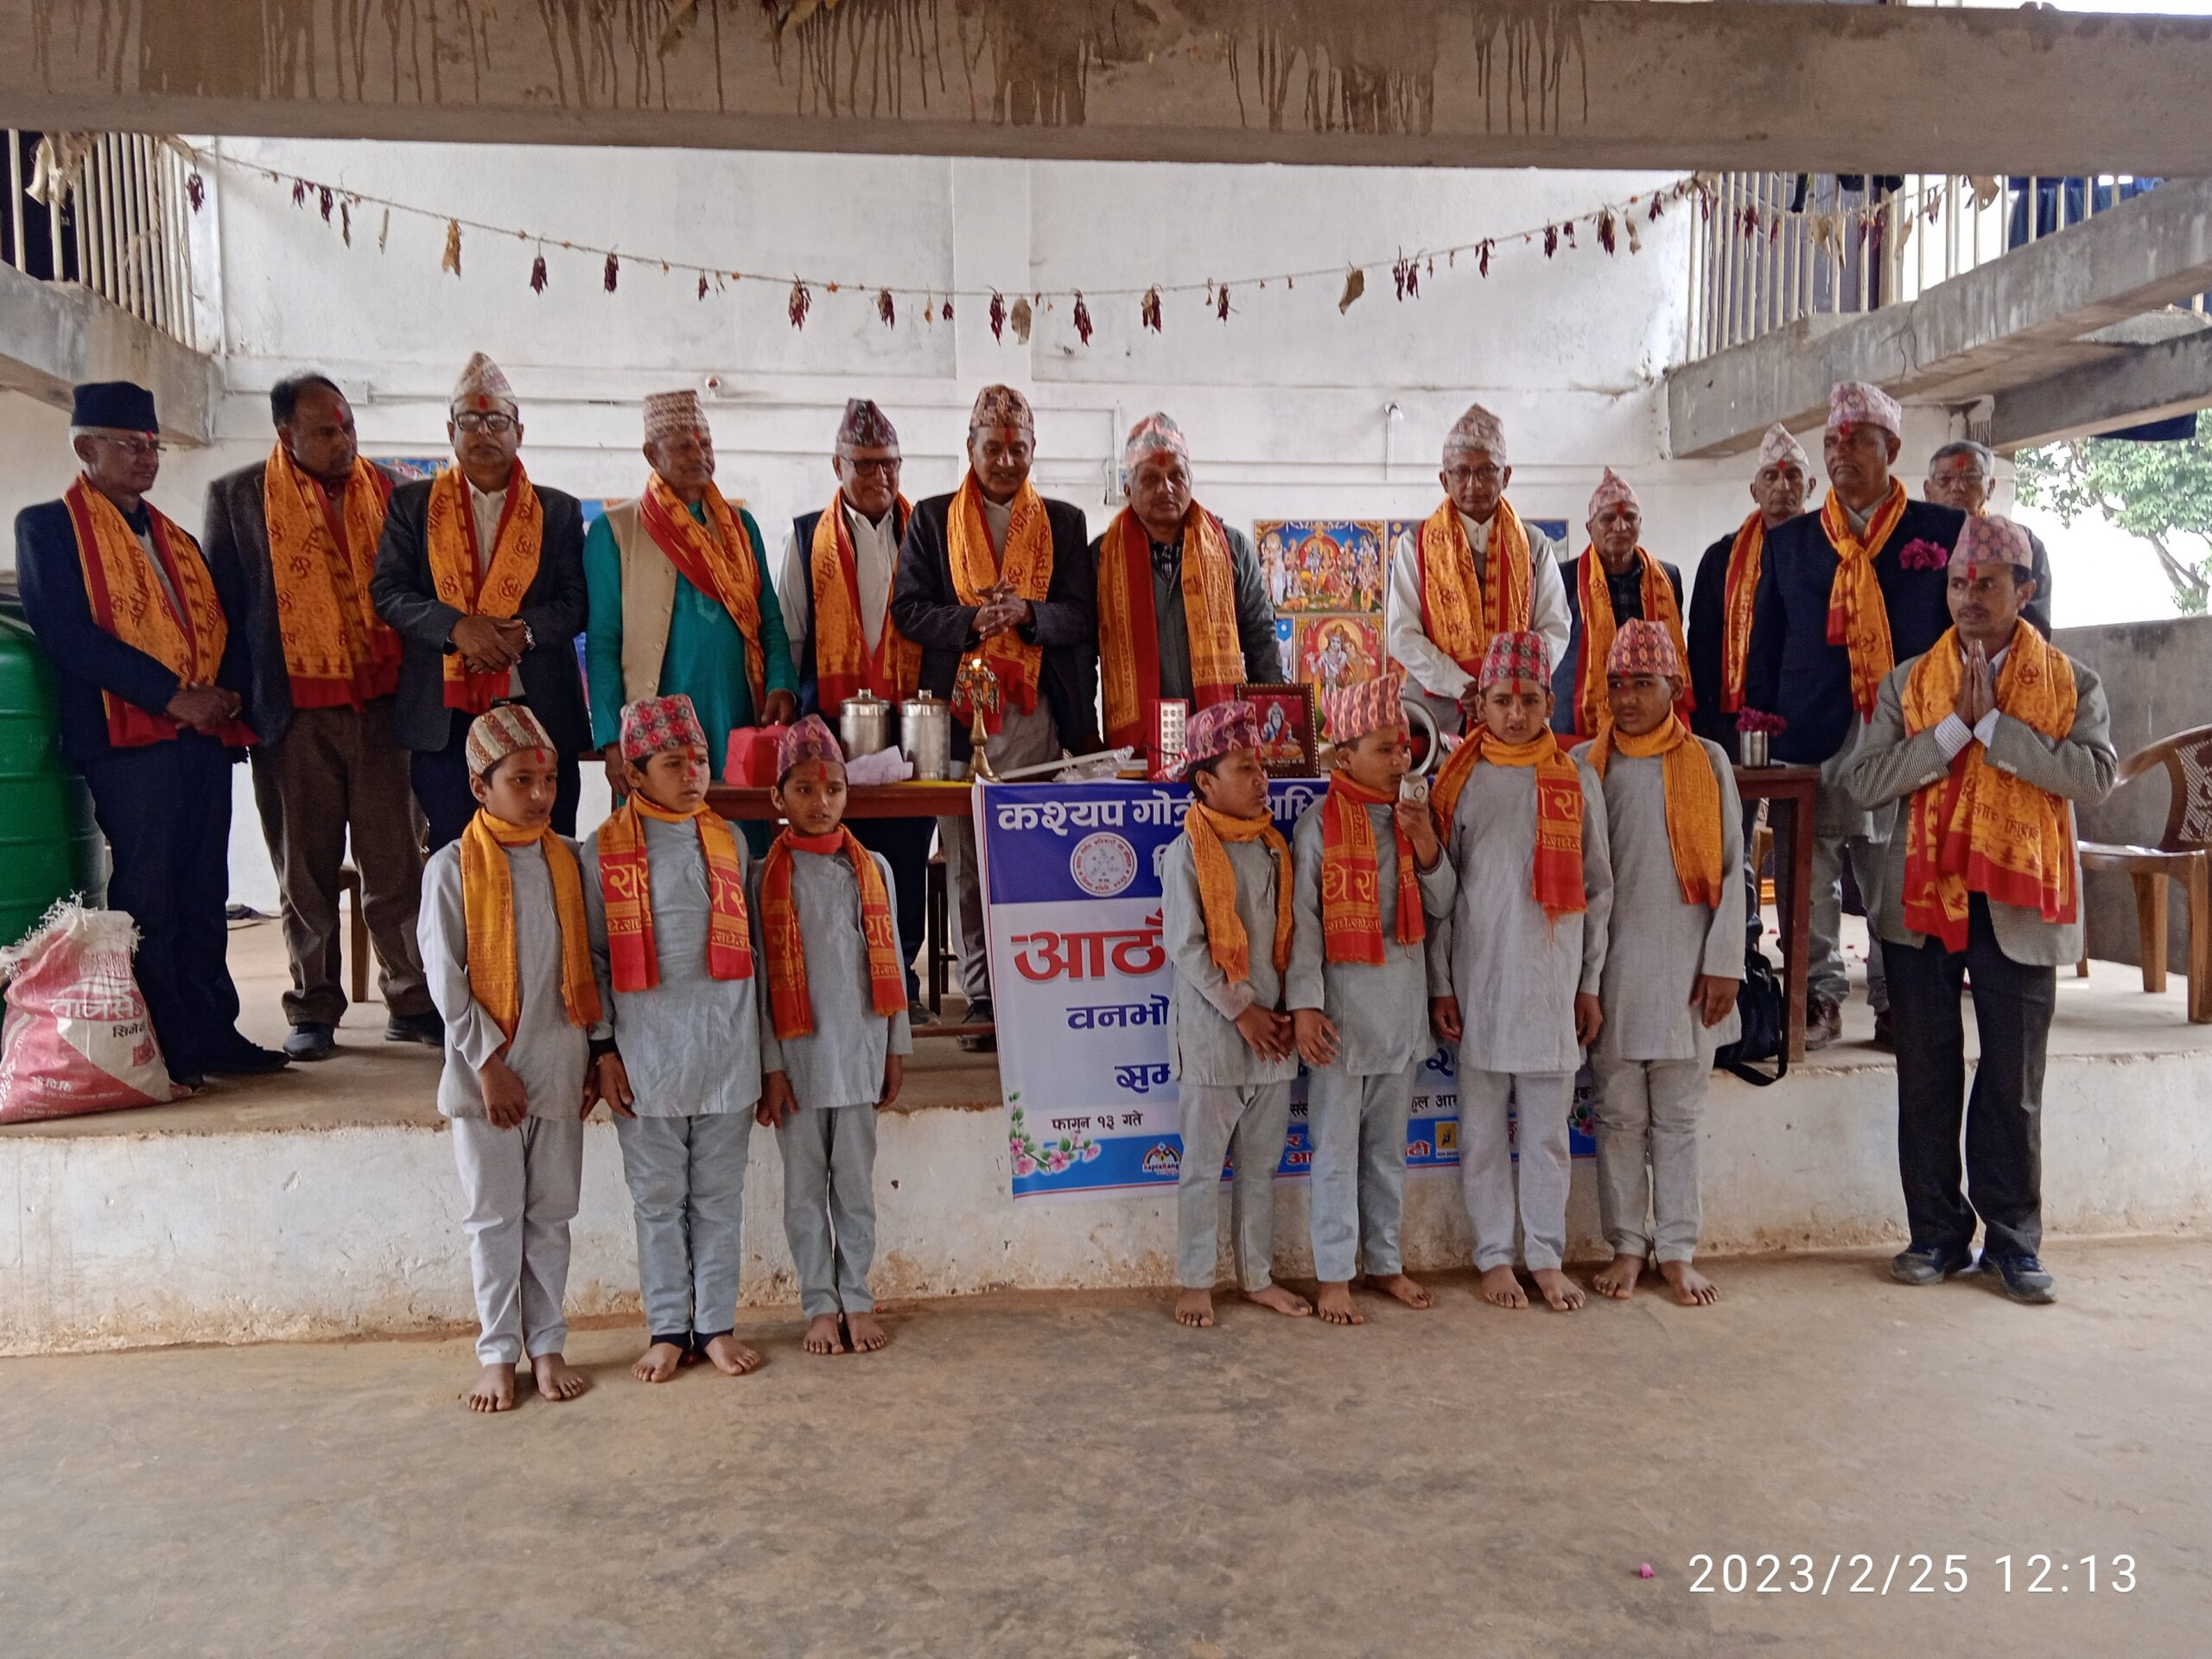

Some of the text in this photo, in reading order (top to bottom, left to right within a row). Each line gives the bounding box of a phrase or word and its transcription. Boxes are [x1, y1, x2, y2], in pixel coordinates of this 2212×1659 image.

[996, 800, 1126, 836] कश्यप
[1066, 994, 1169, 1029] वनभो
[1115, 1063, 1170, 1094] सम
[1051, 1116, 1091, 1135] फागुन
[1097, 1115, 1115, 1130] १३
[1122, 1109, 1144, 1127] गते
